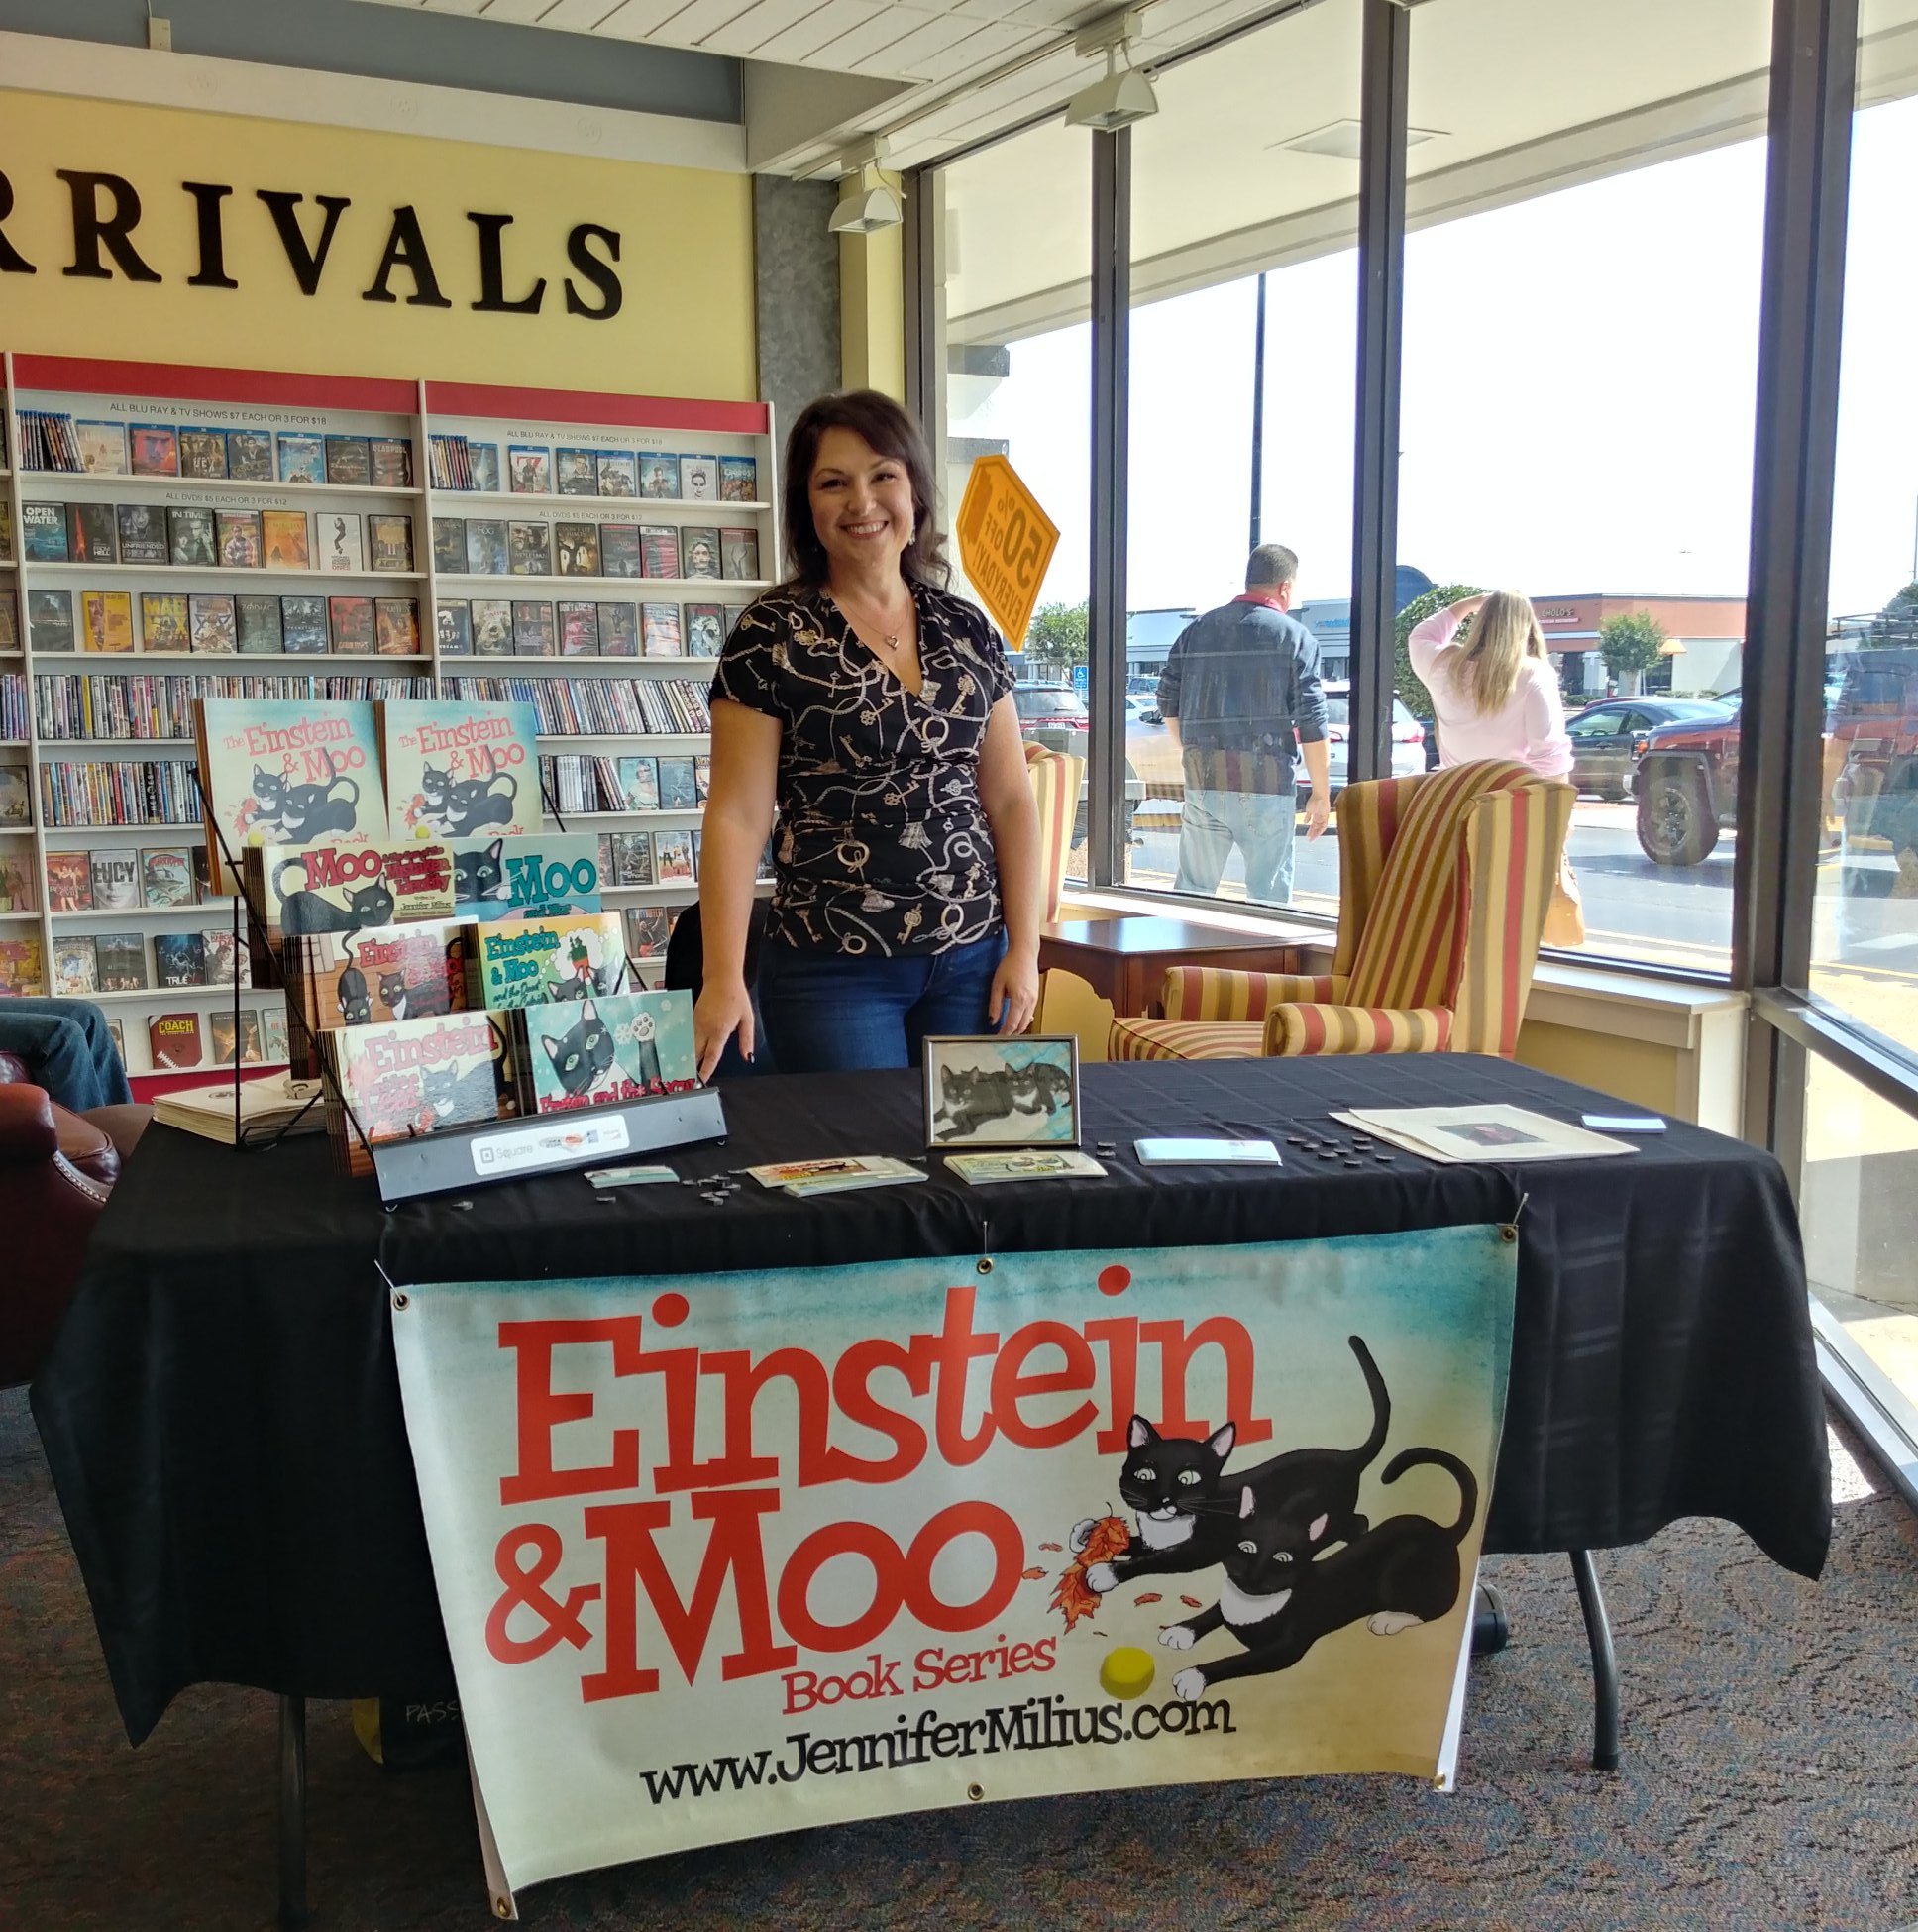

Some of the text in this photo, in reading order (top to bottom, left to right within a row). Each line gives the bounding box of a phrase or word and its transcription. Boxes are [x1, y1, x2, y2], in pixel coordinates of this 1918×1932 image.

[110, 402, 328, 426] ALL BLU RAY & TV SHOWS $7 EACH OR 3 FOR $18
[25, 506, 55, 516] OPEN
[181, 493, 203, 502] DVDS
[215, 495, 237, 504] EACH
[23, 515, 59, 526] WATER
[223, 711, 355, 757] The Einstein
[398, 710, 515, 754] The Einstein
[282, 745, 366, 783] & Moo
[450, 743, 525, 779] & Moo
[92, 861, 136, 884] LUCY
[300, 847, 383, 892] Moo
[505, 855, 597, 908] Moo
[484, 925, 562, 961] Einstein
[491, 959, 540, 986] & Moo
[158, 1020, 194, 1035] COACH
[364, 1016, 499, 1074] Einstein
[496, 1143, 533, 1160] Square
[497, 1265, 1273, 1506] Einstein
[781, 1633, 1058, 1715] Book Series
[639, 1691, 1237, 1806] www.JenniferMilius.com
